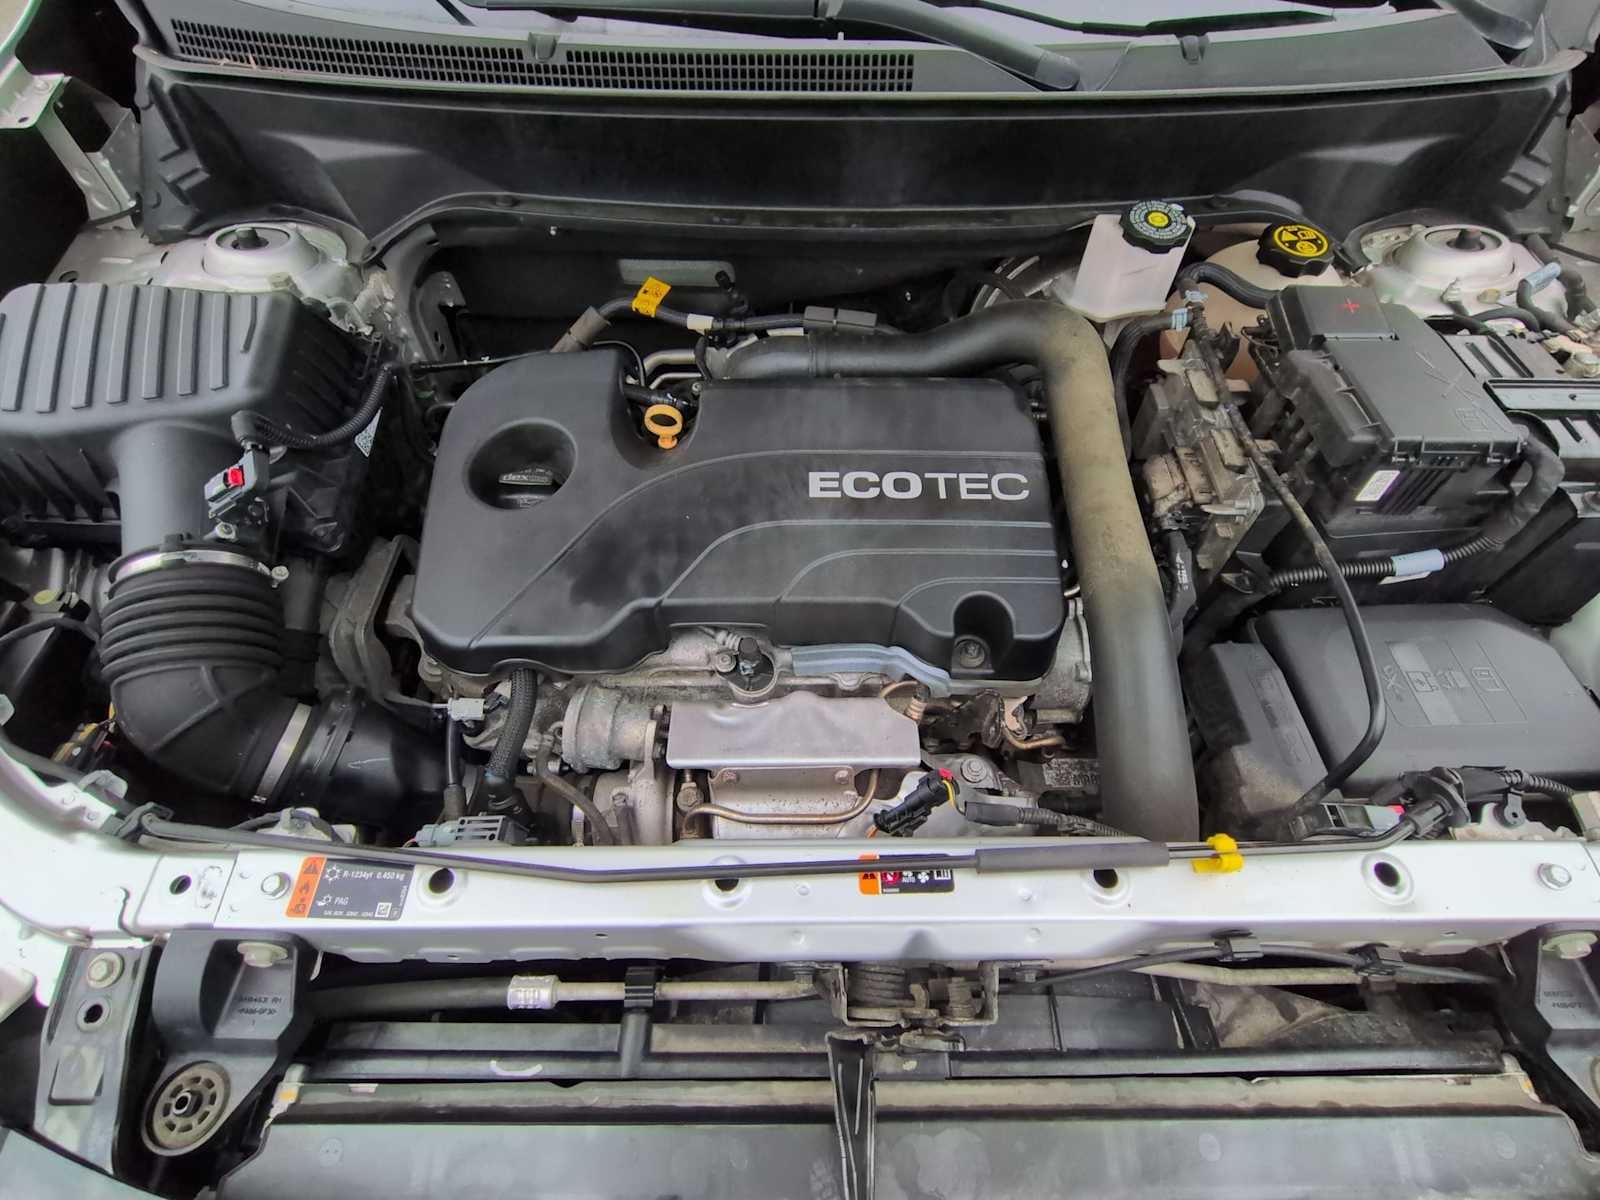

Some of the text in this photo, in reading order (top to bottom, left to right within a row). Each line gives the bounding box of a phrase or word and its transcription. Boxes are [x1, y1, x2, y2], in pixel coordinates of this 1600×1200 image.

[808, 471, 1030, 501] ECOTEC
[396, 872, 405, 881] kg
[334, 896, 349, 905] PAG
